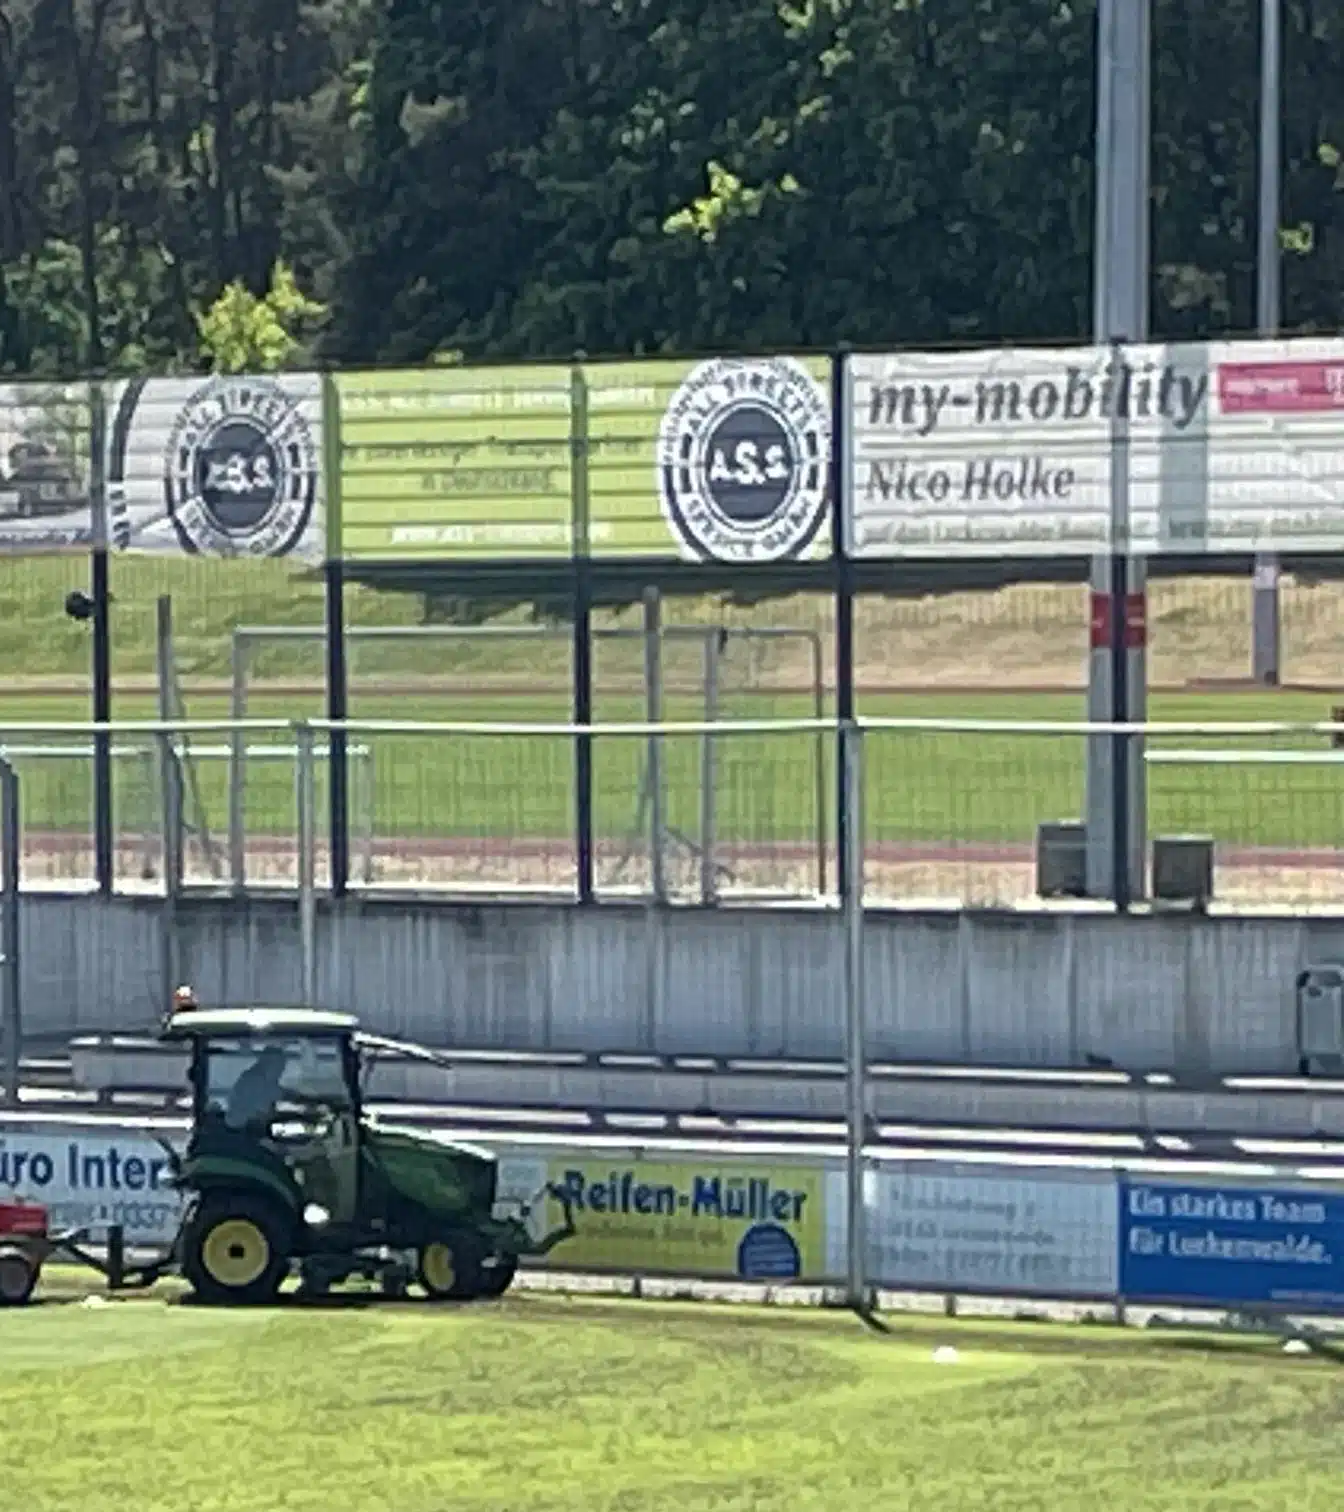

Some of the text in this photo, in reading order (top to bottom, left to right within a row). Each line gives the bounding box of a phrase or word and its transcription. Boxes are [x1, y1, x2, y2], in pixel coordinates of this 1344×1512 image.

[867, 363, 1208, 436] my-mobility
[864, 457, 1075, 501] Nico Holke
[565, 1169, 808, 1221] Reifen-Müller
[1129, 1187, 1326, 1223] Ein starkes Team
